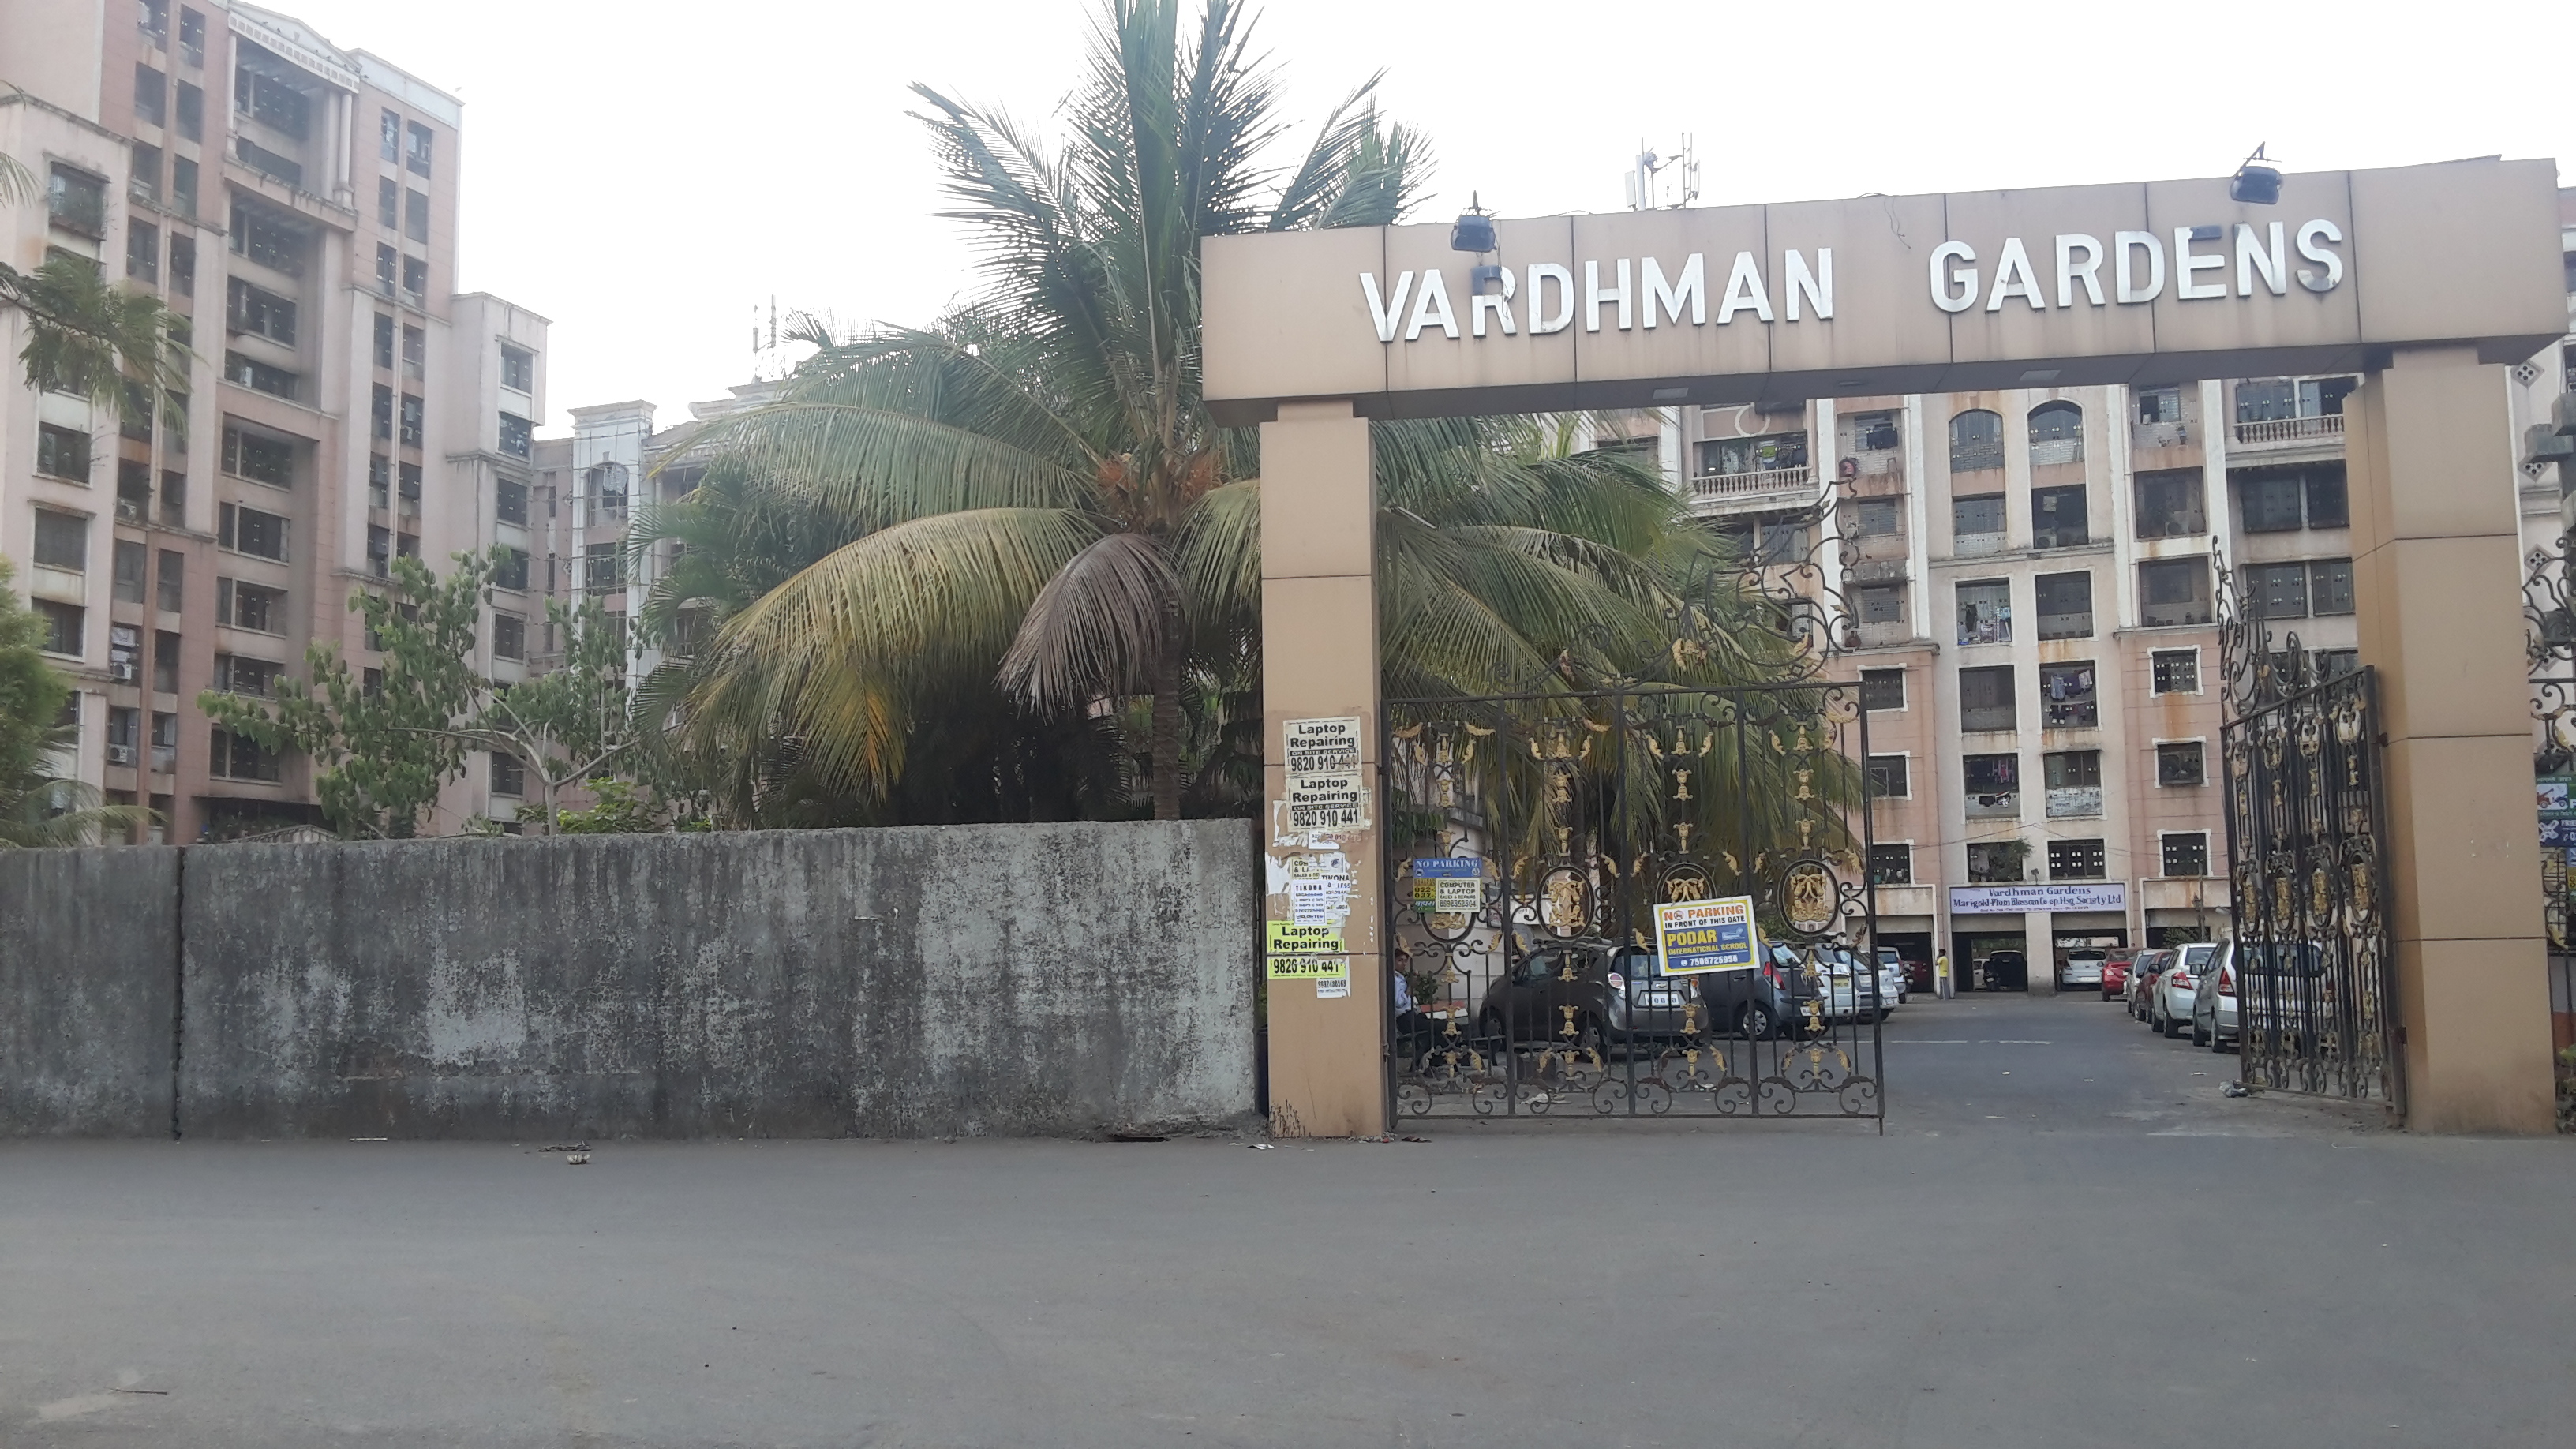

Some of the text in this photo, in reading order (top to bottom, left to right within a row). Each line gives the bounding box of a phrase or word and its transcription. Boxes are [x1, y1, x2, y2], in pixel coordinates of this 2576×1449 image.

[1359, 219, 2344, 342] VARDHMAN GARDENS
[1298, 724, 1346, 736] Laptop
[1290, 736, 1355, 749] Repairing
[1290, 756, 1315, 772] 9820
[1301, 778, 1348, 791] Laptop
[1292, 790, 1357, 803] Repairing
[1293, 808, 1357, 827] 9820 910 441
[2046, 886, 2091, 894] Gardens
[2076, 895, 2106, 905] Society
[1688, 904, 1744, 919] PARKING
[1282, 926, 1329, 938] Laptop
[1666, 930, 1717, 946] PODAR
[1273, 938, 1339, 951] Repairing
[1668, 945, 1720, 955] INTERNATIONAL
